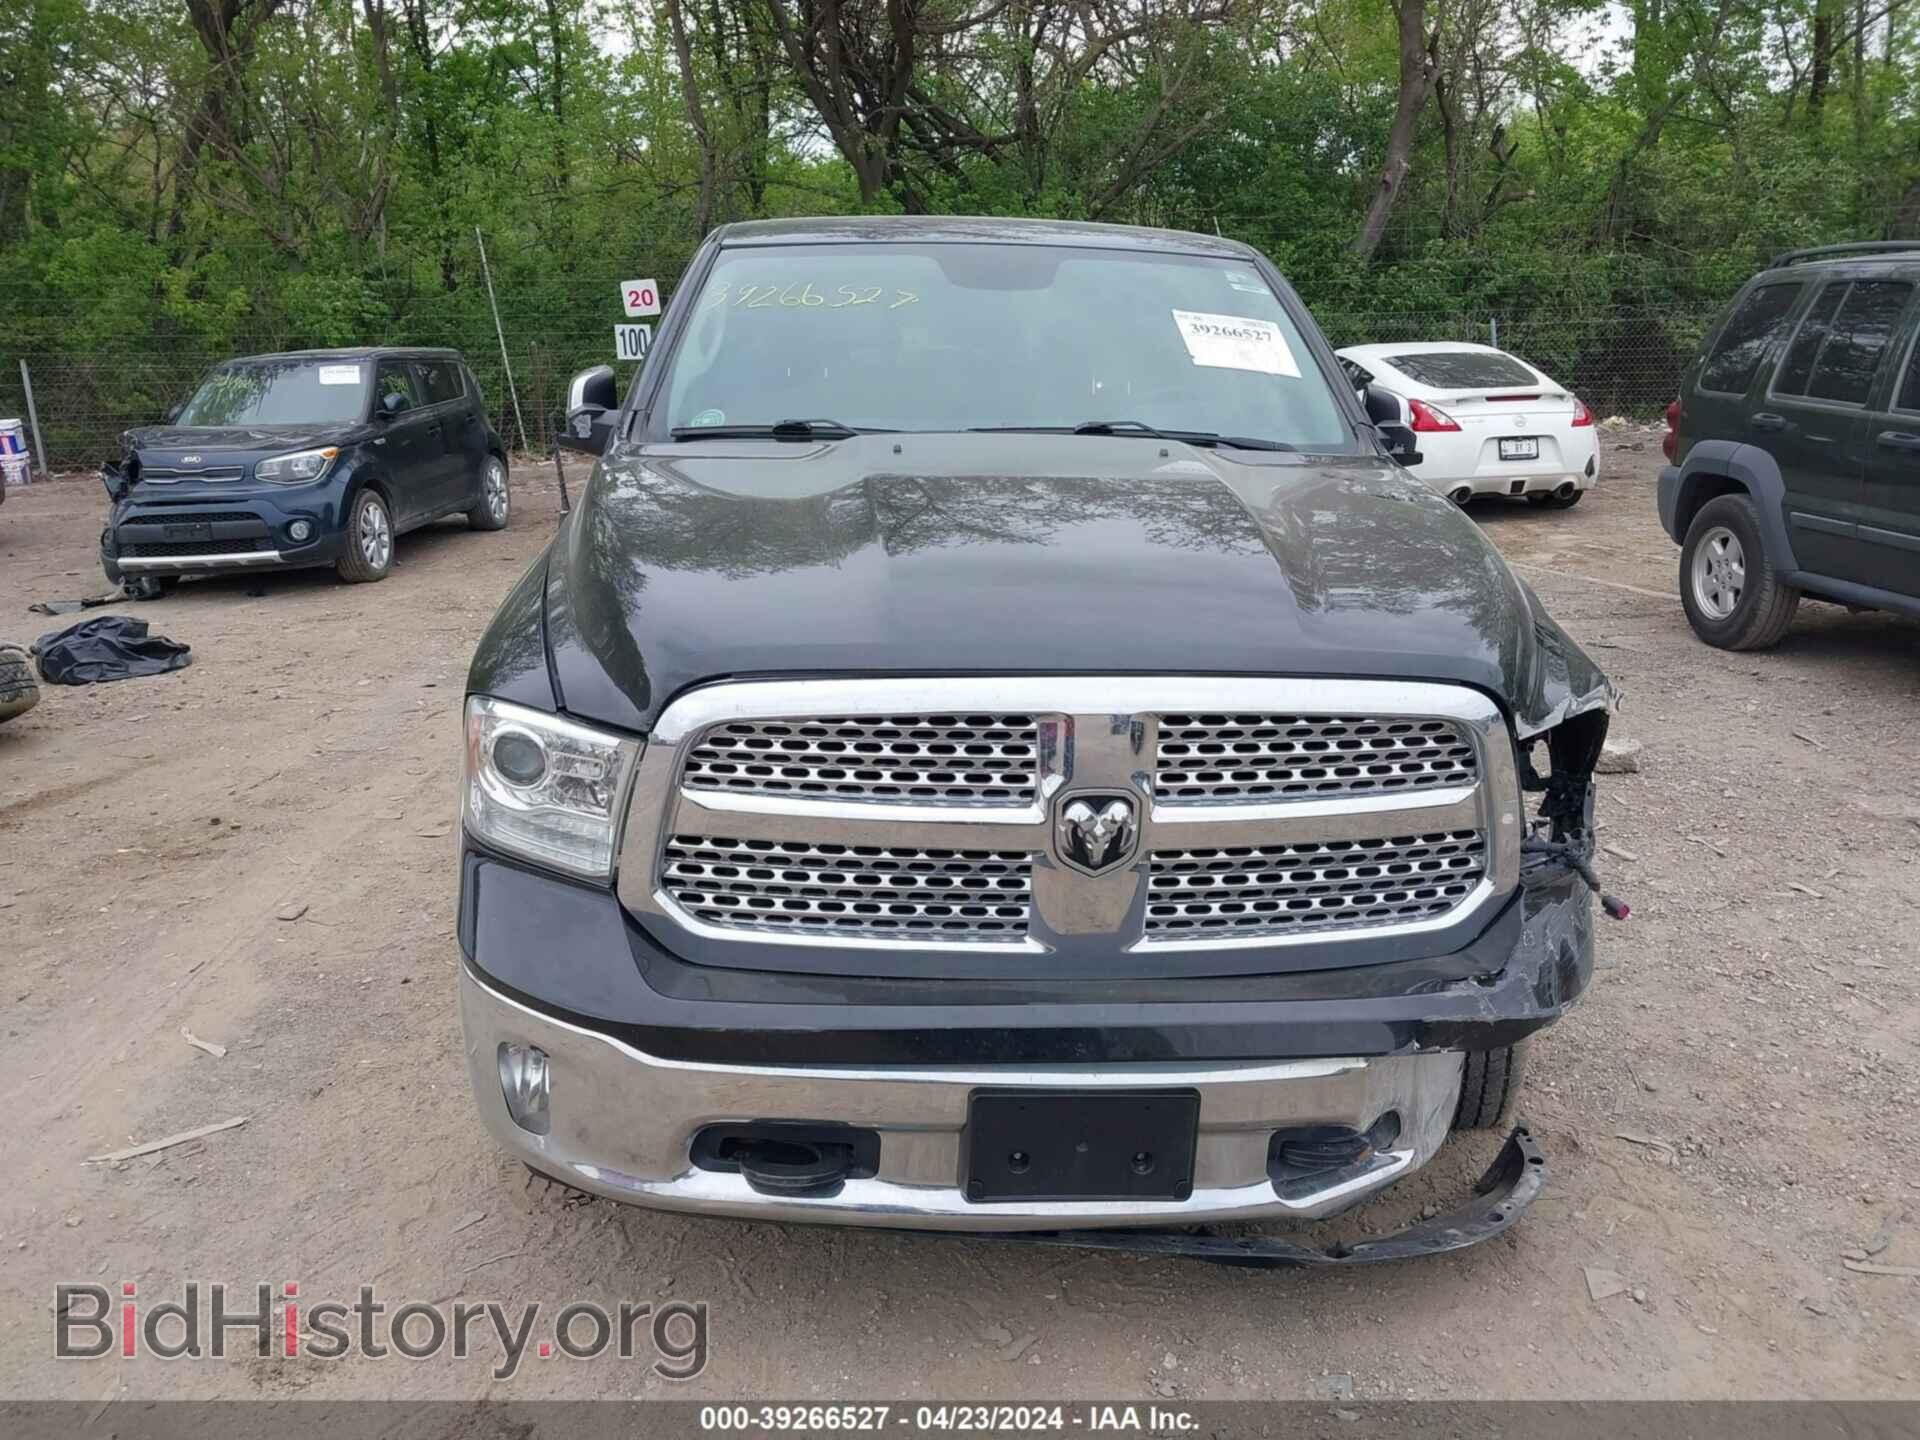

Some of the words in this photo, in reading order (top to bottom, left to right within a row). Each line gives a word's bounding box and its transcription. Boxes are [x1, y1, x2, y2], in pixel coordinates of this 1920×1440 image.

[628, 289, 653, 307] 20
[619, 327, 648, 356] 100
[1190, 322, 1272, 342] 39266527
